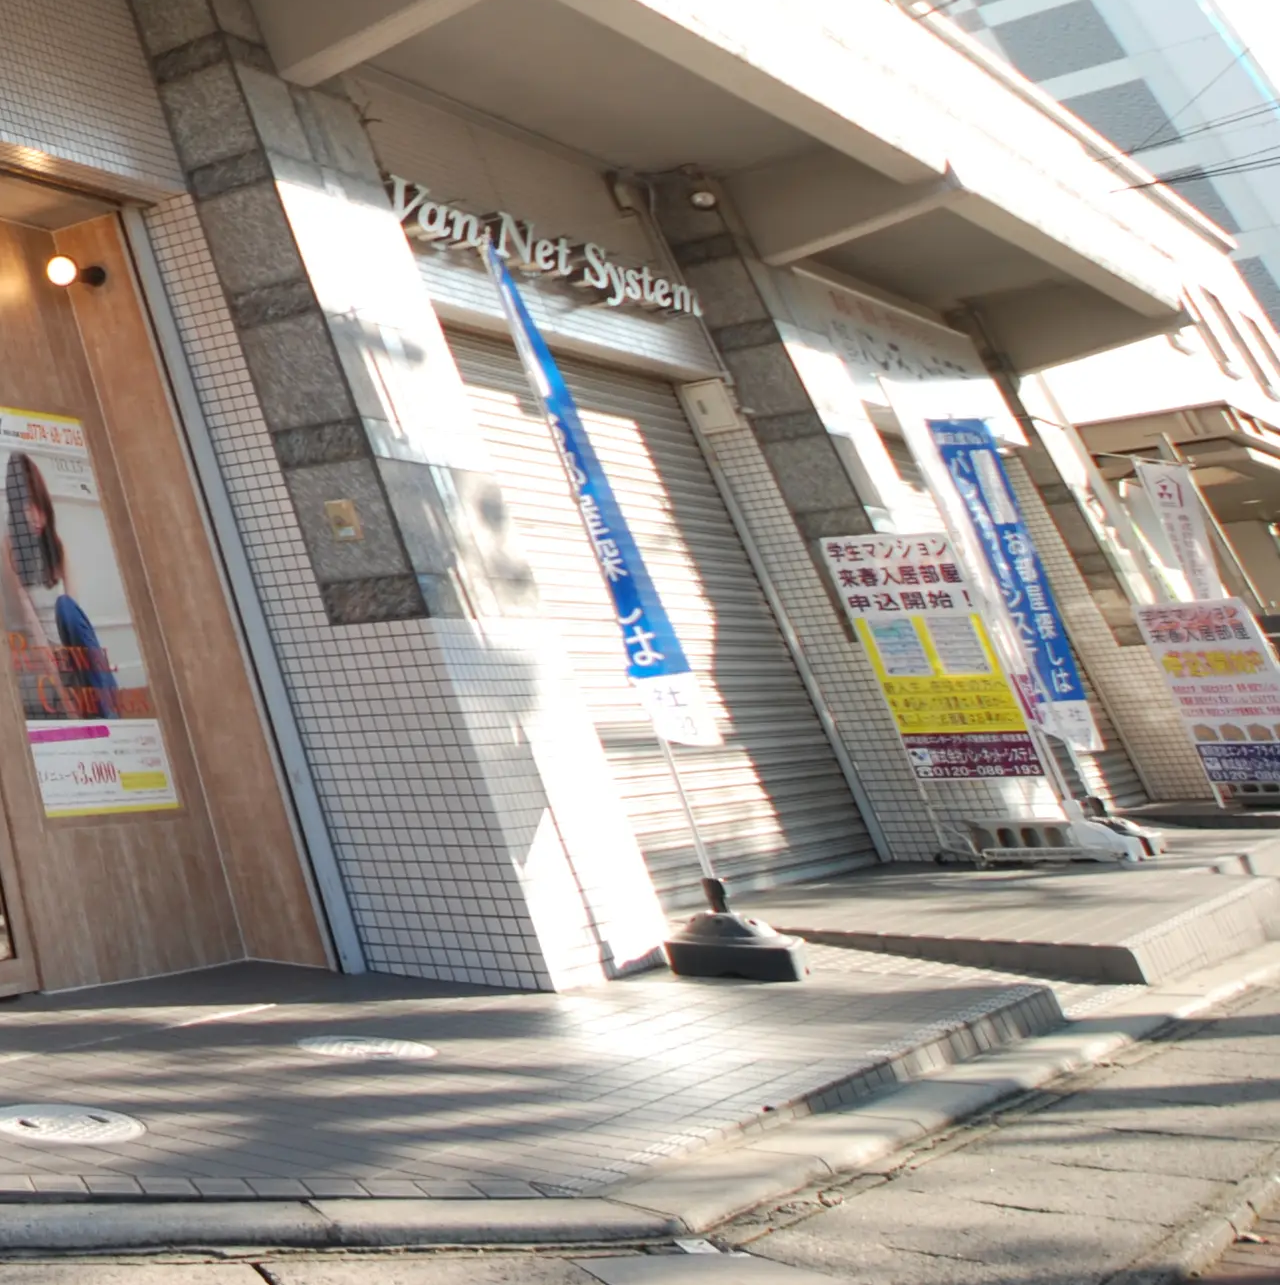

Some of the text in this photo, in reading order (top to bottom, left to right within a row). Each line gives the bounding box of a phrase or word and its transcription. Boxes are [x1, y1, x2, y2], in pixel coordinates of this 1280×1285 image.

[390, 174, 703, 317] Van Net System
[826, 538, 947, 563] 学生マンション
[837, 563, 963, 588] 来春入居部屋
[1003, 528, 1076, 694] お部屋探しは
[932, 765, 1042, 777] 0120-086-193
